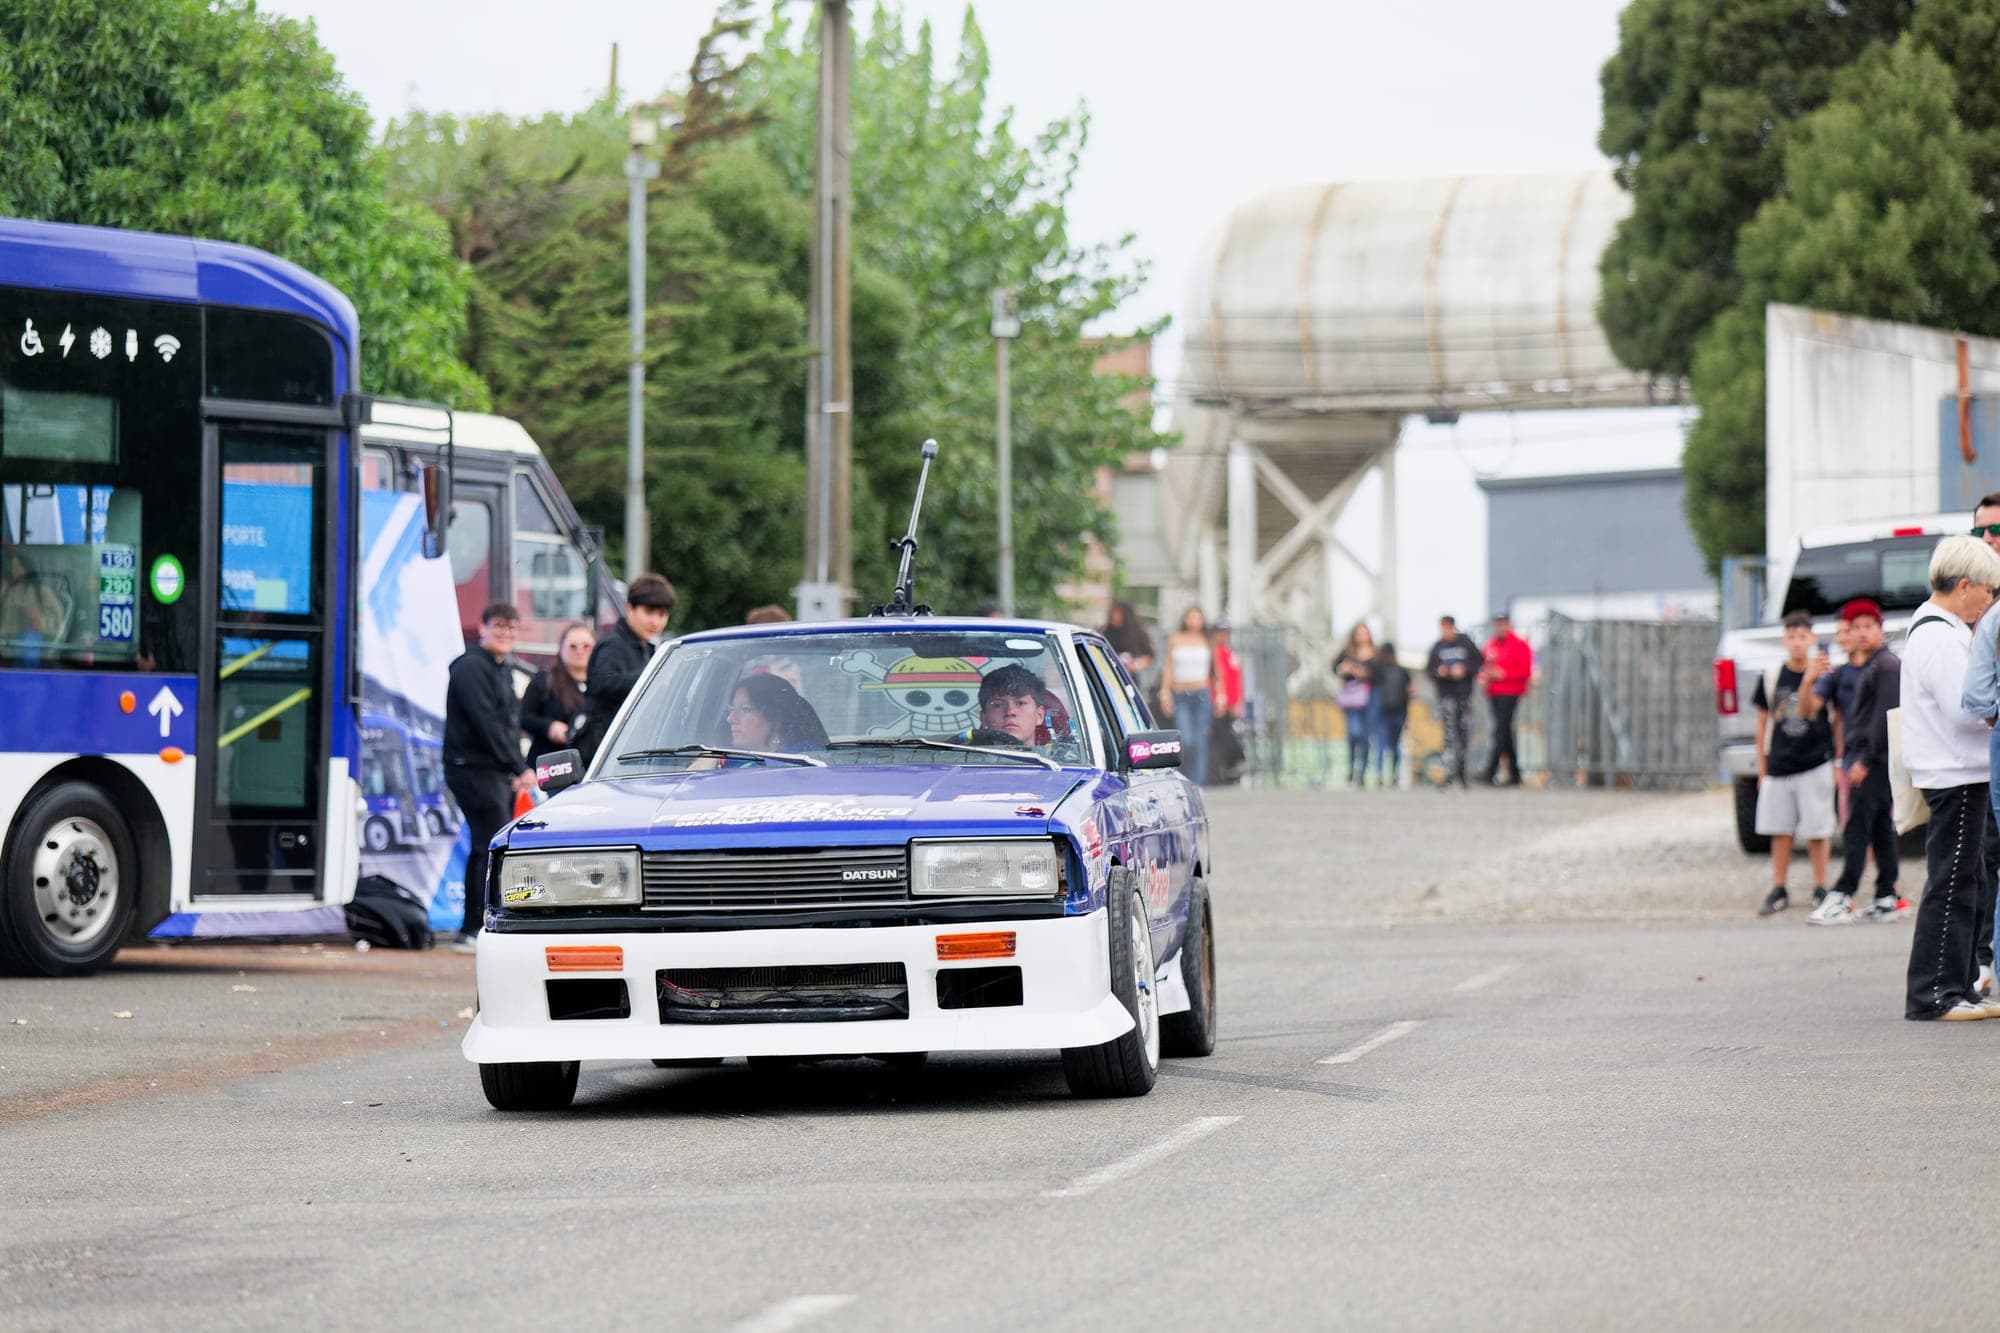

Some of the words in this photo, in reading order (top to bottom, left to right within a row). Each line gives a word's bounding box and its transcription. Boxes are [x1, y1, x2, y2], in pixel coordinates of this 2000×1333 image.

[101, 606, 133, 638] 580
[1150, 742, 1180, 755] cars
[549, 762, 573, 777] cars
[843, 869, 897, 880] DATSUN
